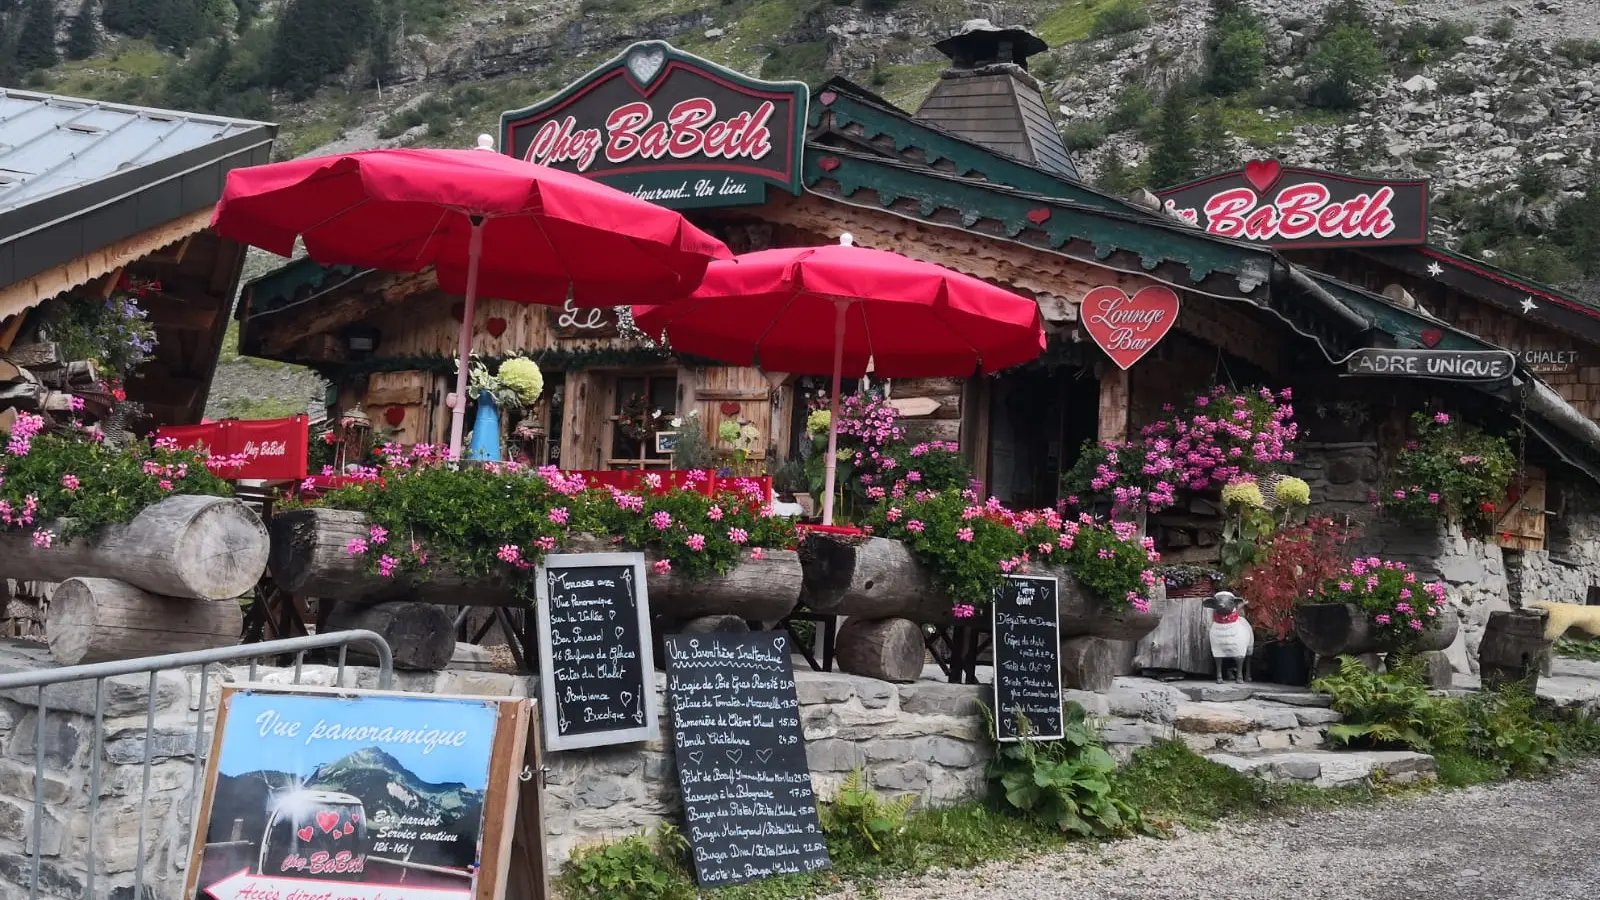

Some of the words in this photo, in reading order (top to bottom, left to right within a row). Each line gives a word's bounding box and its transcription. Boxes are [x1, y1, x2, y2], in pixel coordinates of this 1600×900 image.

[524, 115, 602, 172] Chez
[605, 97, 776, 163] BaBeth
[694, 179, 715, 197] Un
[1203, 182, 1395, 240] BaBeth
[558, 298, 608, 329] Le
[1090, 297, 1166, 331] Lounge
[1107, 326, 1151, 350] Bar
[1525, 351, 1577, 364] CHALET
[243, 441, 259, 460] Chez
[260, 441, 287, 456] BaBeth
[558, 572, 595, 589] Terrasse
[597, 580, 615, 588] avec
[552, 595, 570, 608] Vue
[570, 593, 613, 608] Panoramique
[567, 612, 577, 622] la
[577, 609, 605, 622] Vallée
[572, 626, 604, 643] Parasol
[564, 648, 594, 665] Parfums
[596, 647, 608, 659] de
[609, 644, 636, 664] Glaces
[666, 638, 689, 659] Une
[554, 667, 580, 681] Tartes
[581, 665, 595, 679] du
[597, 663, 627, 679] Chalet
[702, 675, 714, 690] de
[731, 673, 751, 694] Gras
[564, 685, 611, 703] Ambiance
[701, 694, 713, 708] de
[717, 713, 728, 727] de
[255, 708, 301, 738] Vue
[304, 718, 467, 755] panoramique
[703, 769, 712, 782] de
[726, 785, 736, 799] la
[374, 810, 396, 824] Bar
[399, 815, 440, 829] parasol
[376, 827, 417, 841] Service
[420, 832, 459, 843] continu
[281, 854, 307, 873] Chez
[309, 851, 367, 875] BaBeth
[234, 882, 281, 900] Accès
